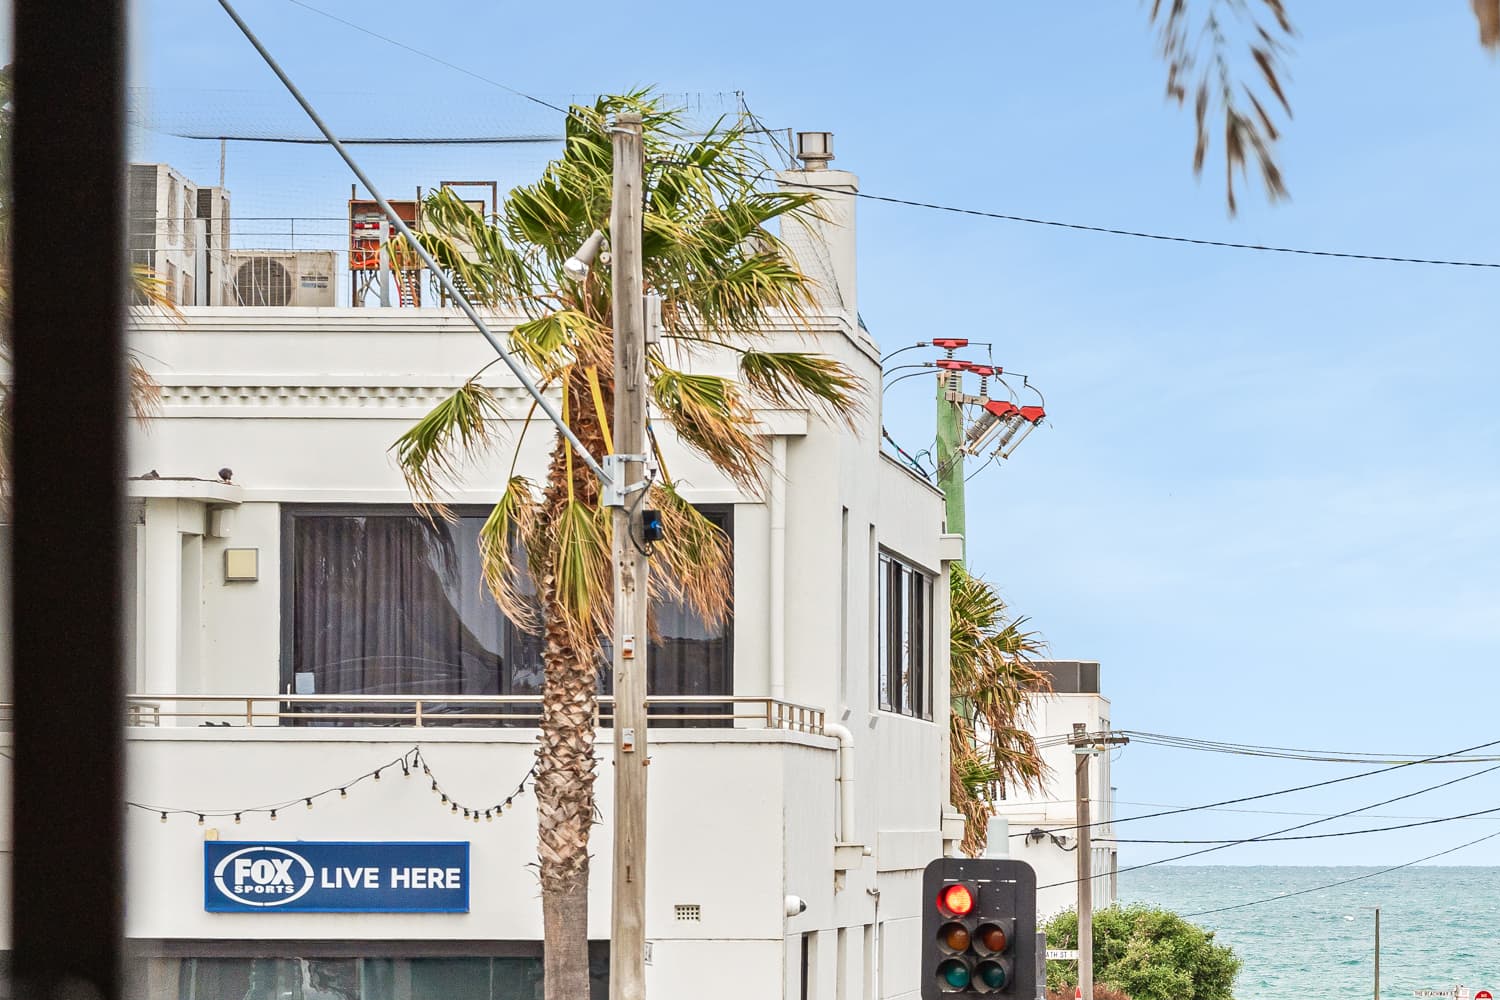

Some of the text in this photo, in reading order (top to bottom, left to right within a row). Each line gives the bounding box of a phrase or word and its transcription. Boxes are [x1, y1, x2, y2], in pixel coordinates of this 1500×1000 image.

[234, 858, 294, 886] FOX
[321, 867, 461, 889] LIVE HERE
[233, 885, 295, 894] SPORTS
